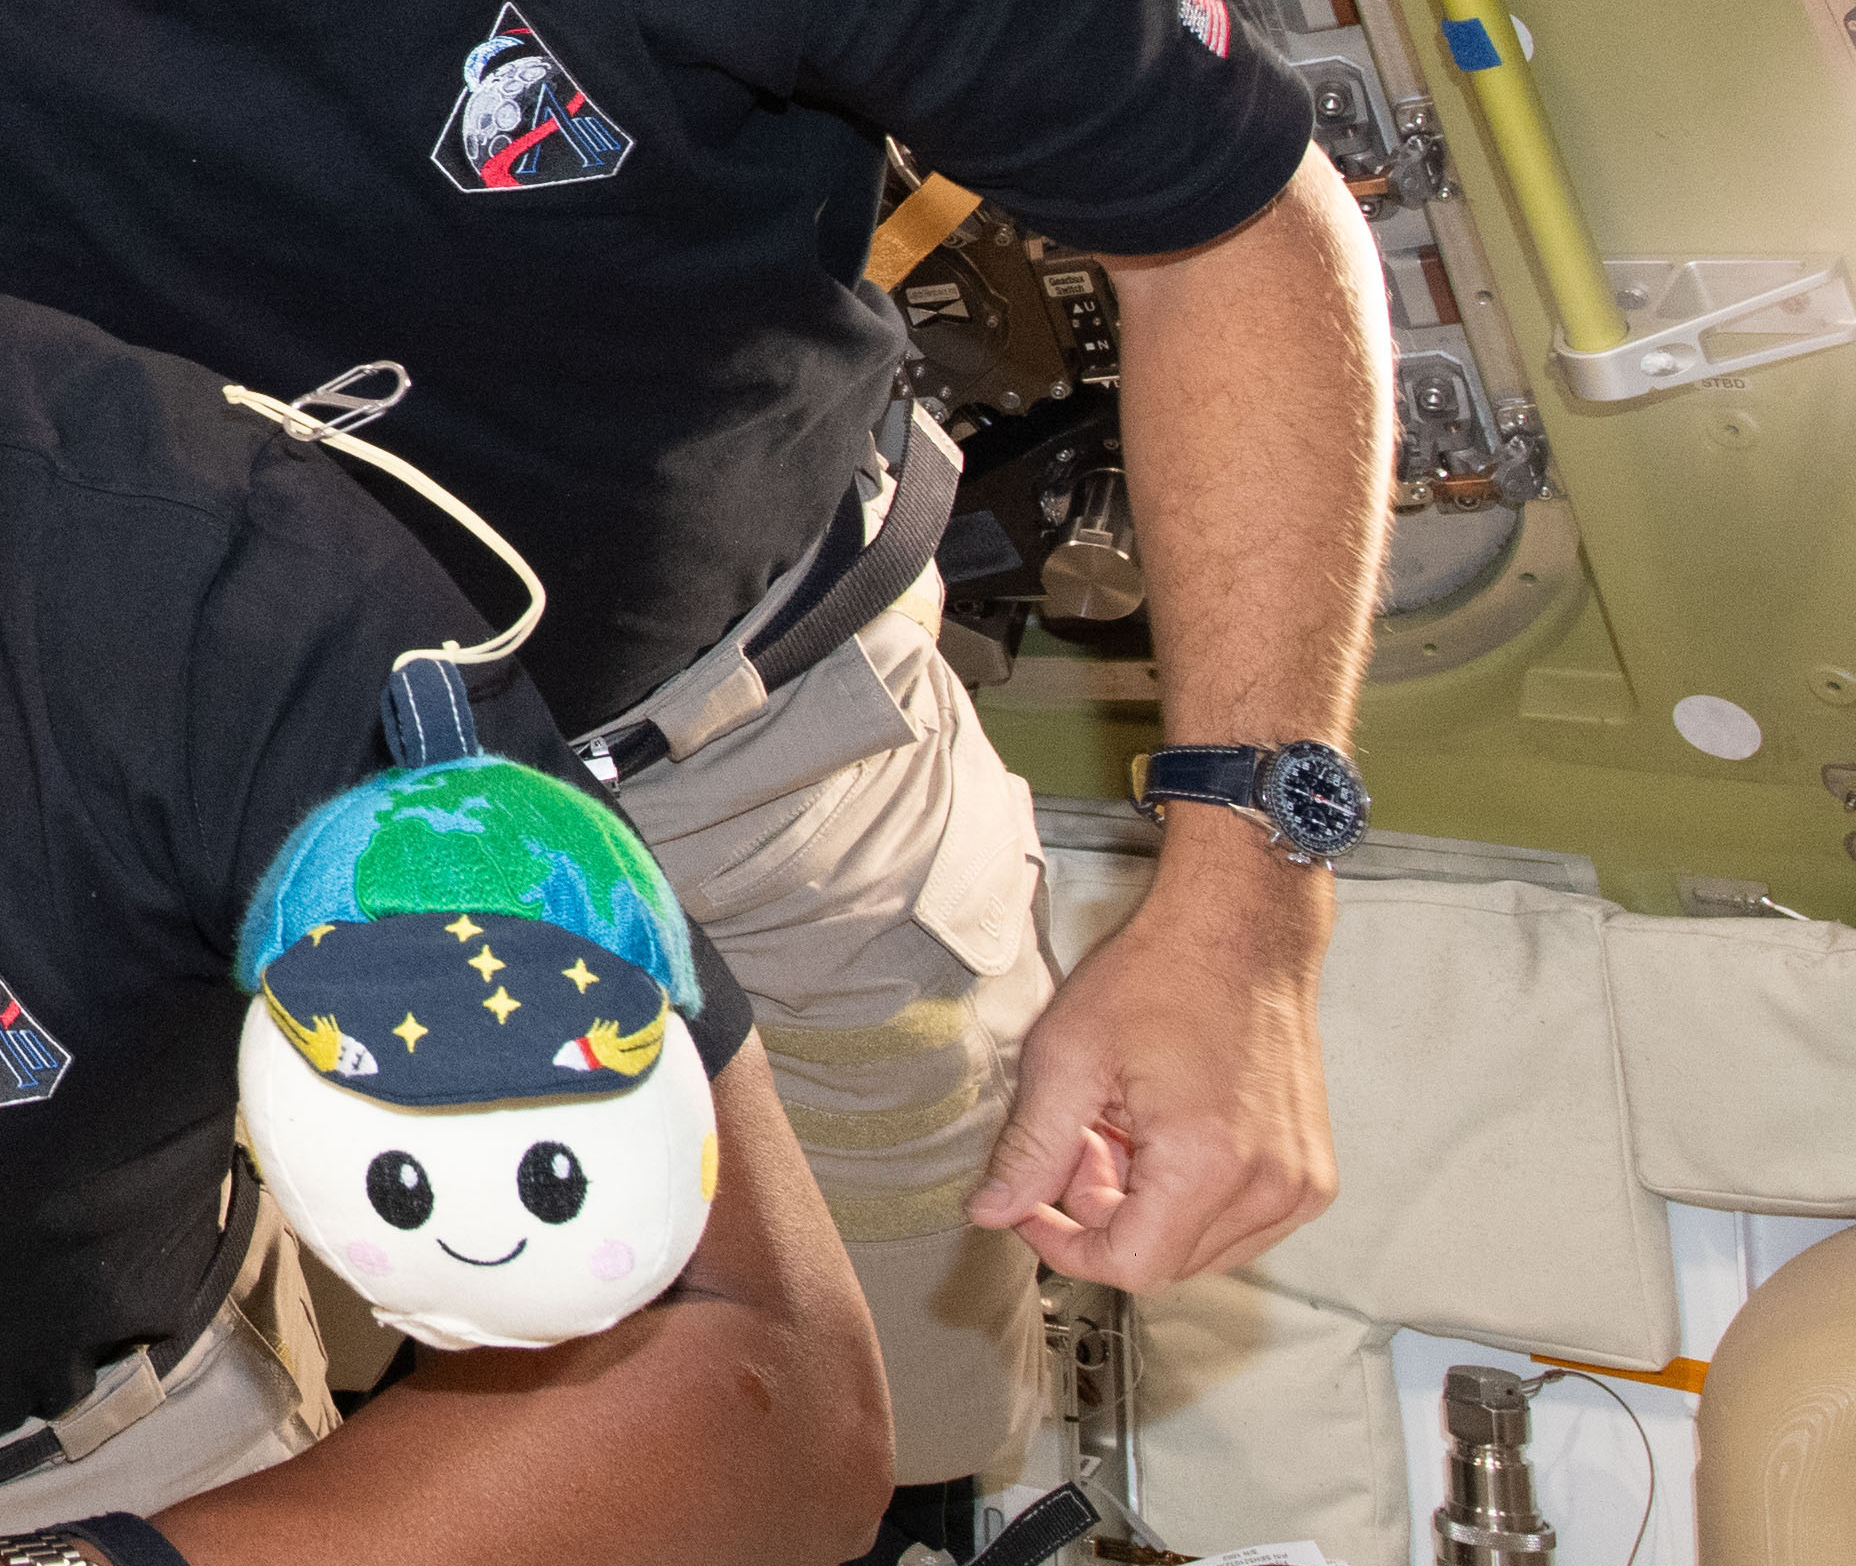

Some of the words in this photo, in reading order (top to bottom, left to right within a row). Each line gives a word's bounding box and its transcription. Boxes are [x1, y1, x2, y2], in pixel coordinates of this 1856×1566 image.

[1048, 275, 1086, 285] Gearbox
[1055, 284, 1086, 294] Switch
[1084, 302, 1096, 312] U
[1097, 339, 1109, 350] N
[1703, 377, 1746, 389] STBD
